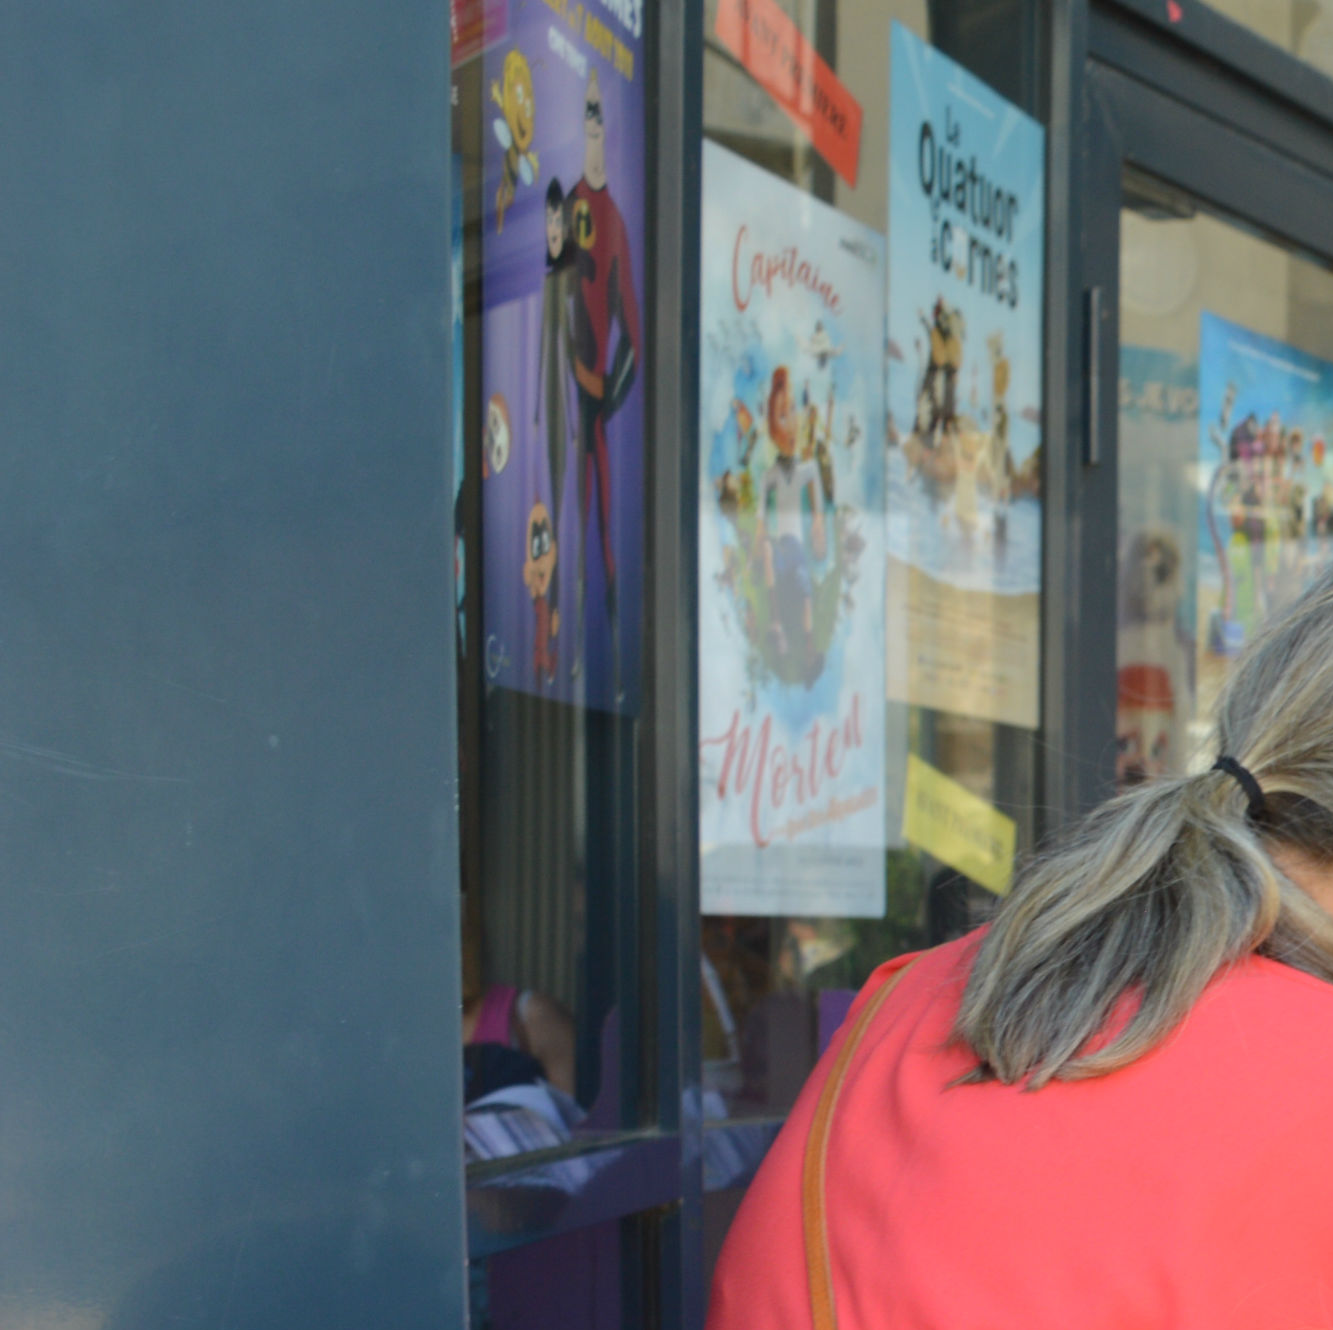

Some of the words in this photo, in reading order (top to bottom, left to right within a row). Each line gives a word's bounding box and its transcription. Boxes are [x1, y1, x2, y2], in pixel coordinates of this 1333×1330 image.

[946, 105, 961, 147] Le
[919, 120, 1019, 244] Quatuor
[732, 223, 844, 317] Capitaine
[698, 690, 863, 849] Morten
